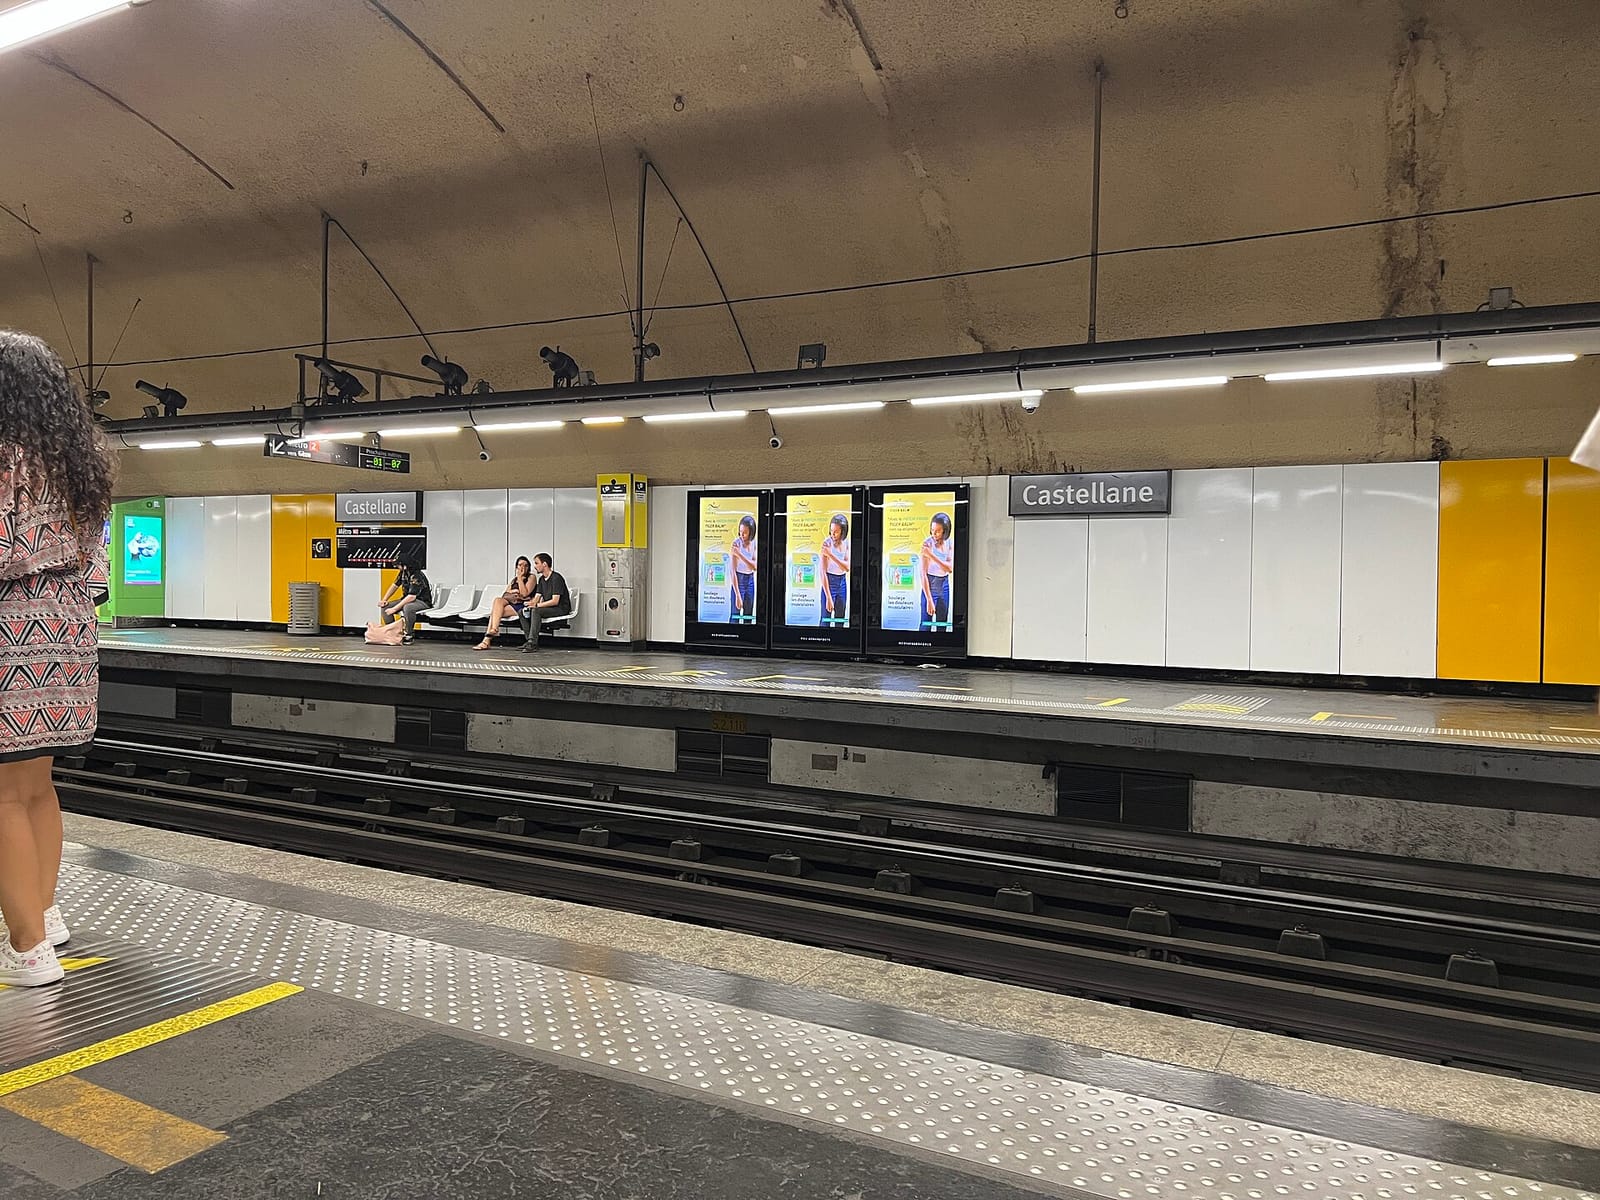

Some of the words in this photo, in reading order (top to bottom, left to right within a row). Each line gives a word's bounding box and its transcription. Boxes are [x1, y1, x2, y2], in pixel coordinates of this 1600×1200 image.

[373, 457, 382, 467] 01
[391, 459, 401, 469] 07
[1022, 481, 1153, 506] Castellane
[345, 499, 407, 515] Castellane
